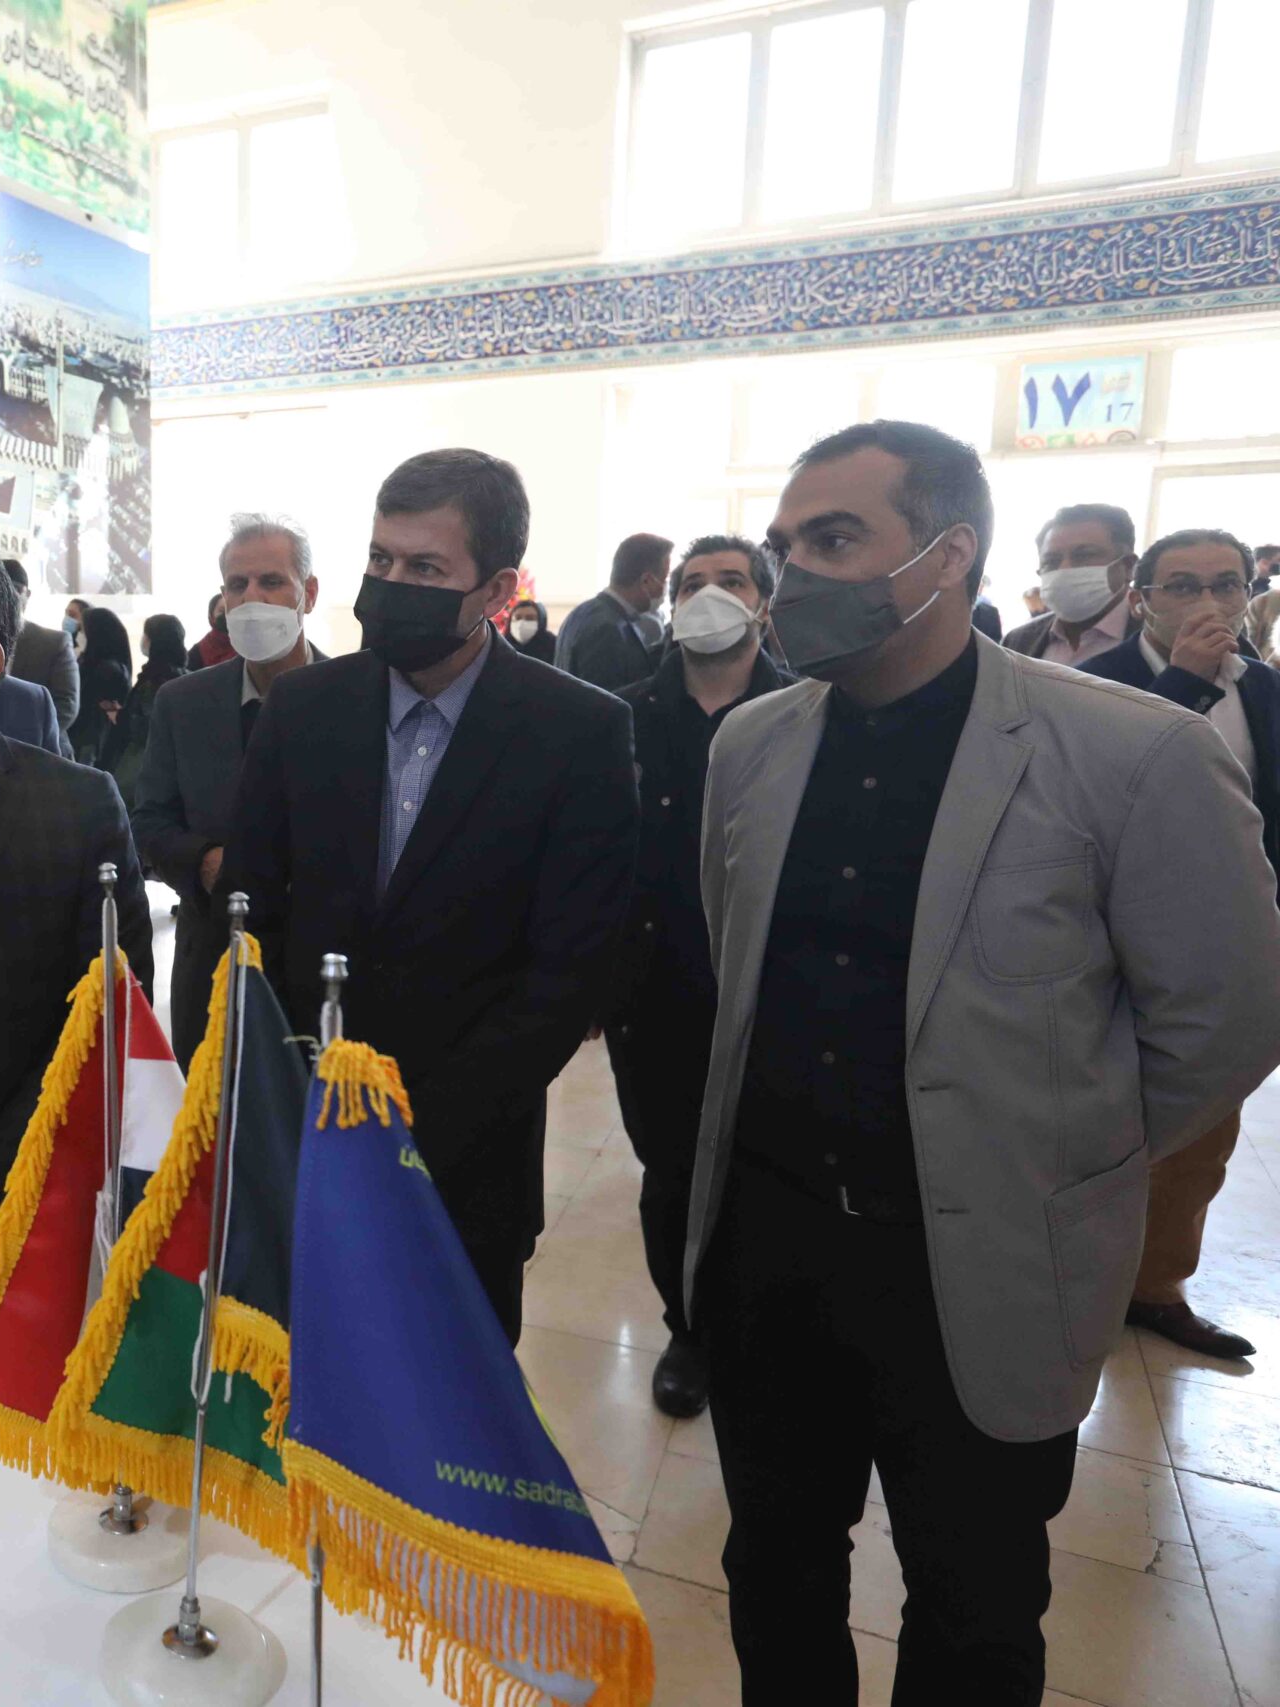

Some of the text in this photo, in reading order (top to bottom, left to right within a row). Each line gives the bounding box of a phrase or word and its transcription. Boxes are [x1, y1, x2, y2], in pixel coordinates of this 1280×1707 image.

[1023, 370, 1092, 430] ۱۷
[1105, 401, 1135, 423] 17
[435, 1460, 591, 1518] www.sadra
